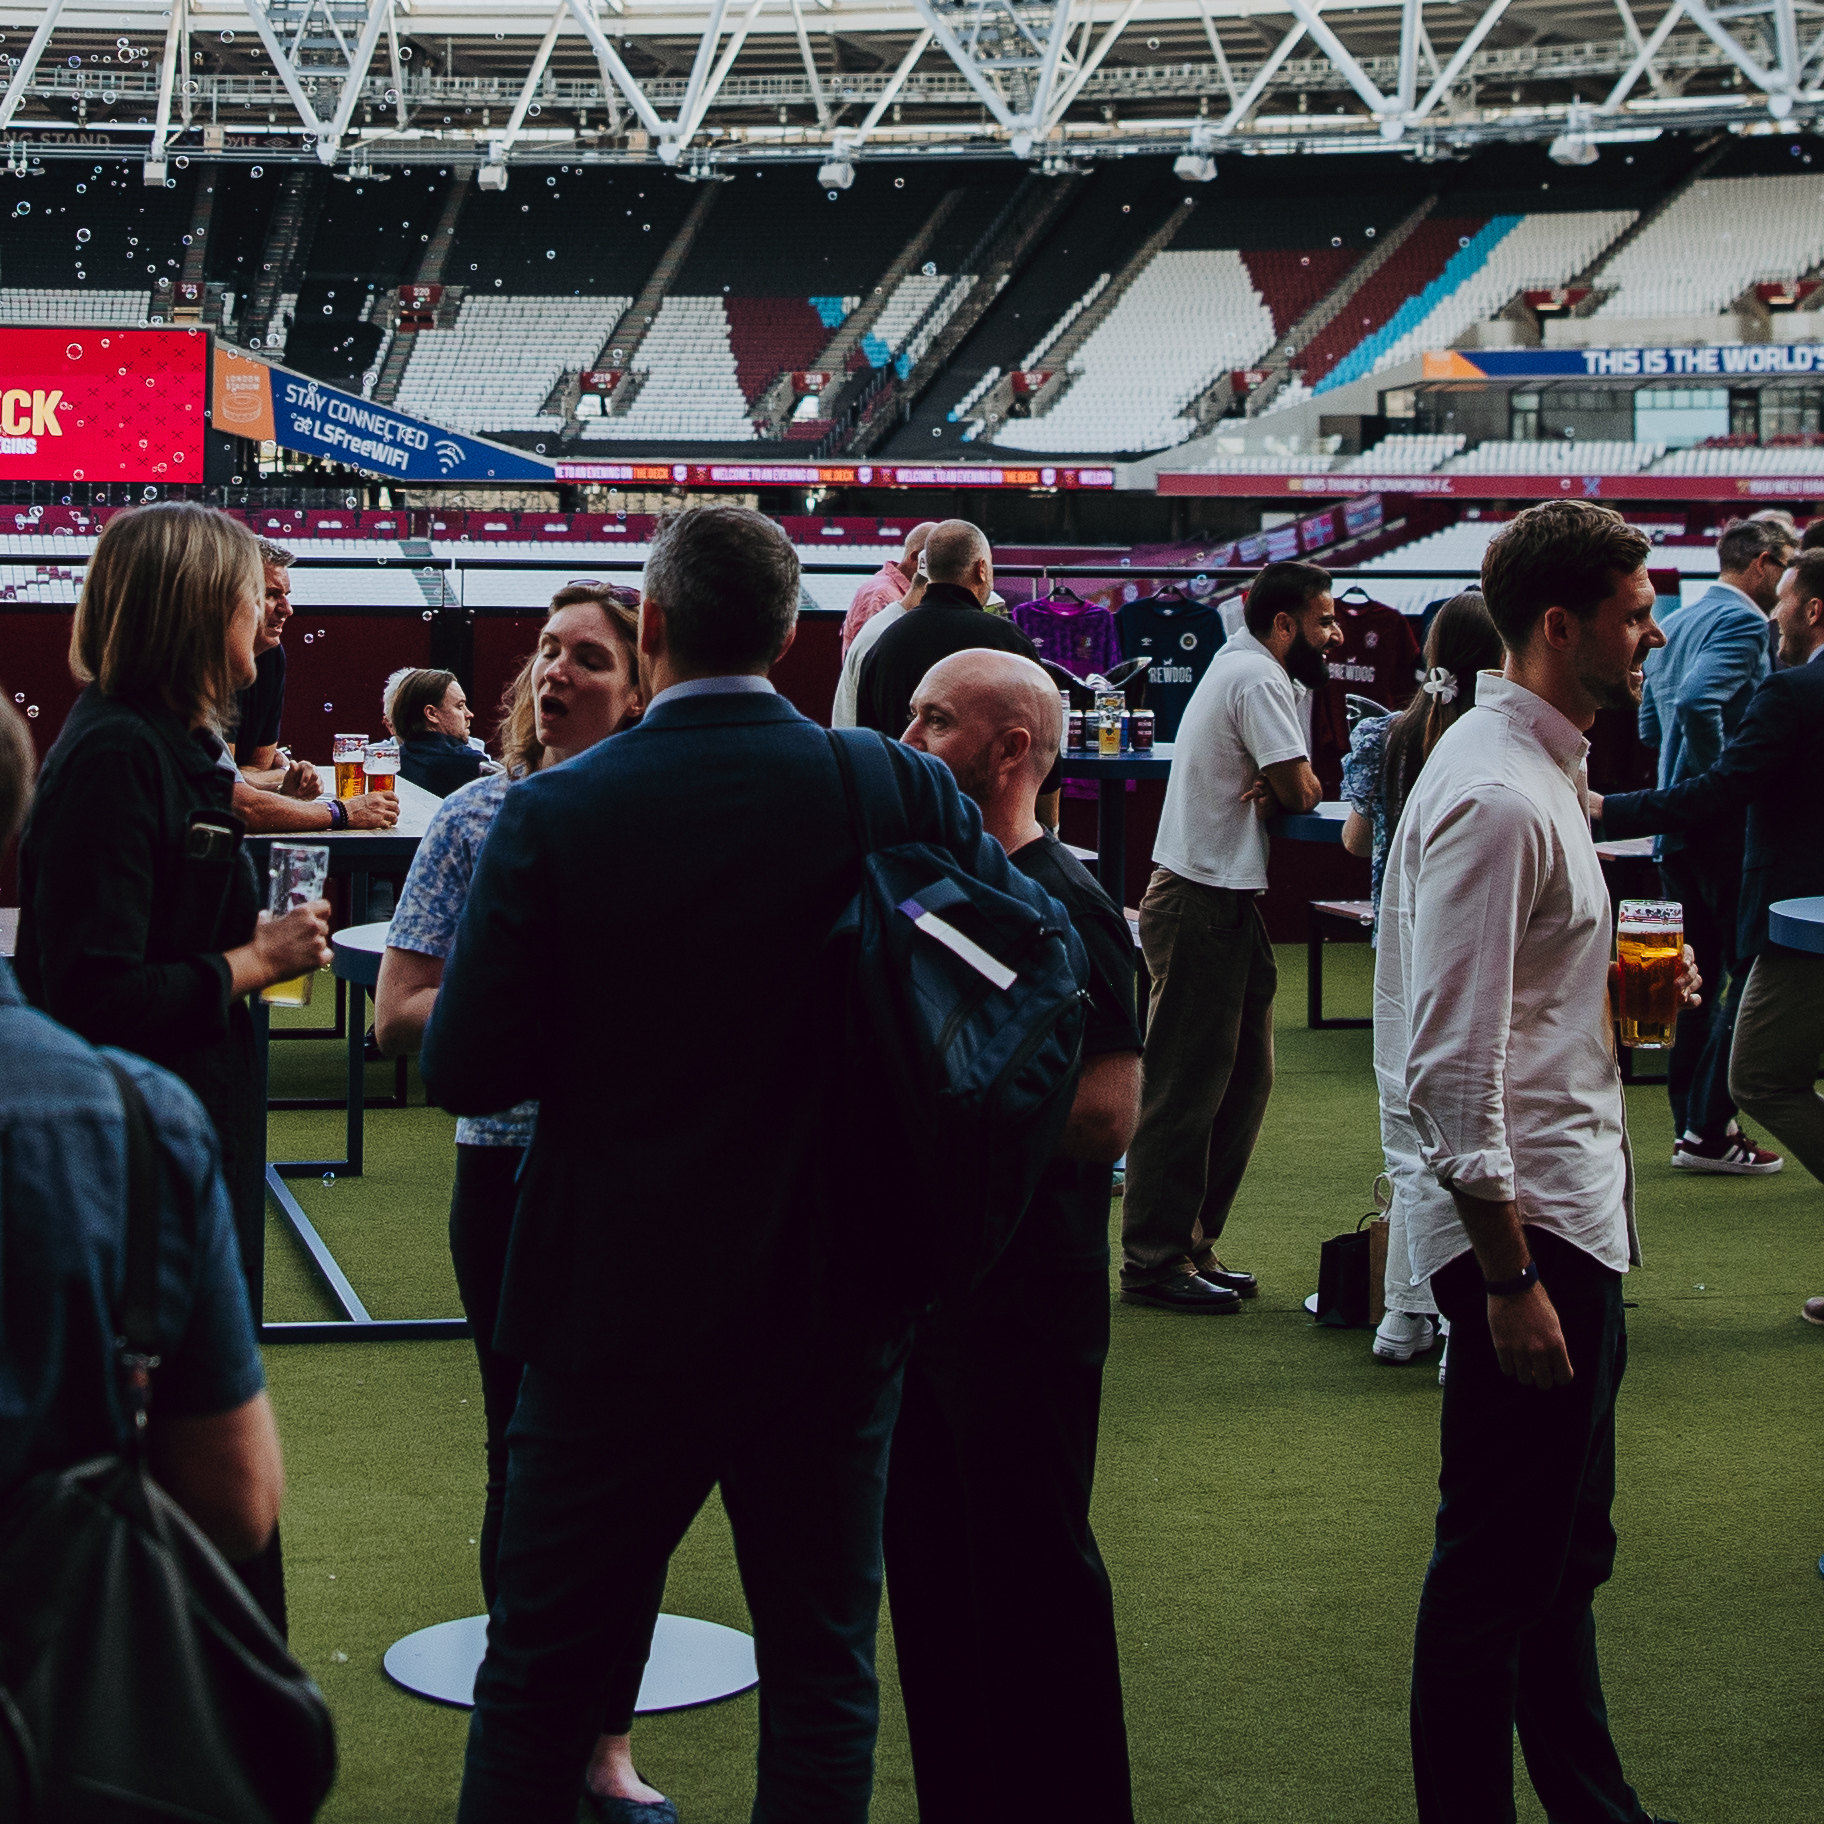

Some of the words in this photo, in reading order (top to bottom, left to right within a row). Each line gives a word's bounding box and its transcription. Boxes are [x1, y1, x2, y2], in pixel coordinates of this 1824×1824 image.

[1582, 350, 1640, 375] THIS
[1643, 349, 1668, 374] IS
[1669, 348, 1720, 374] THE
[285, 383, 327, 414] STAY
[328, 399, 429, 451] CONNECTED
[293, 415, 311, 435] at
[1148, 667, 1192, 683] REWDOG
